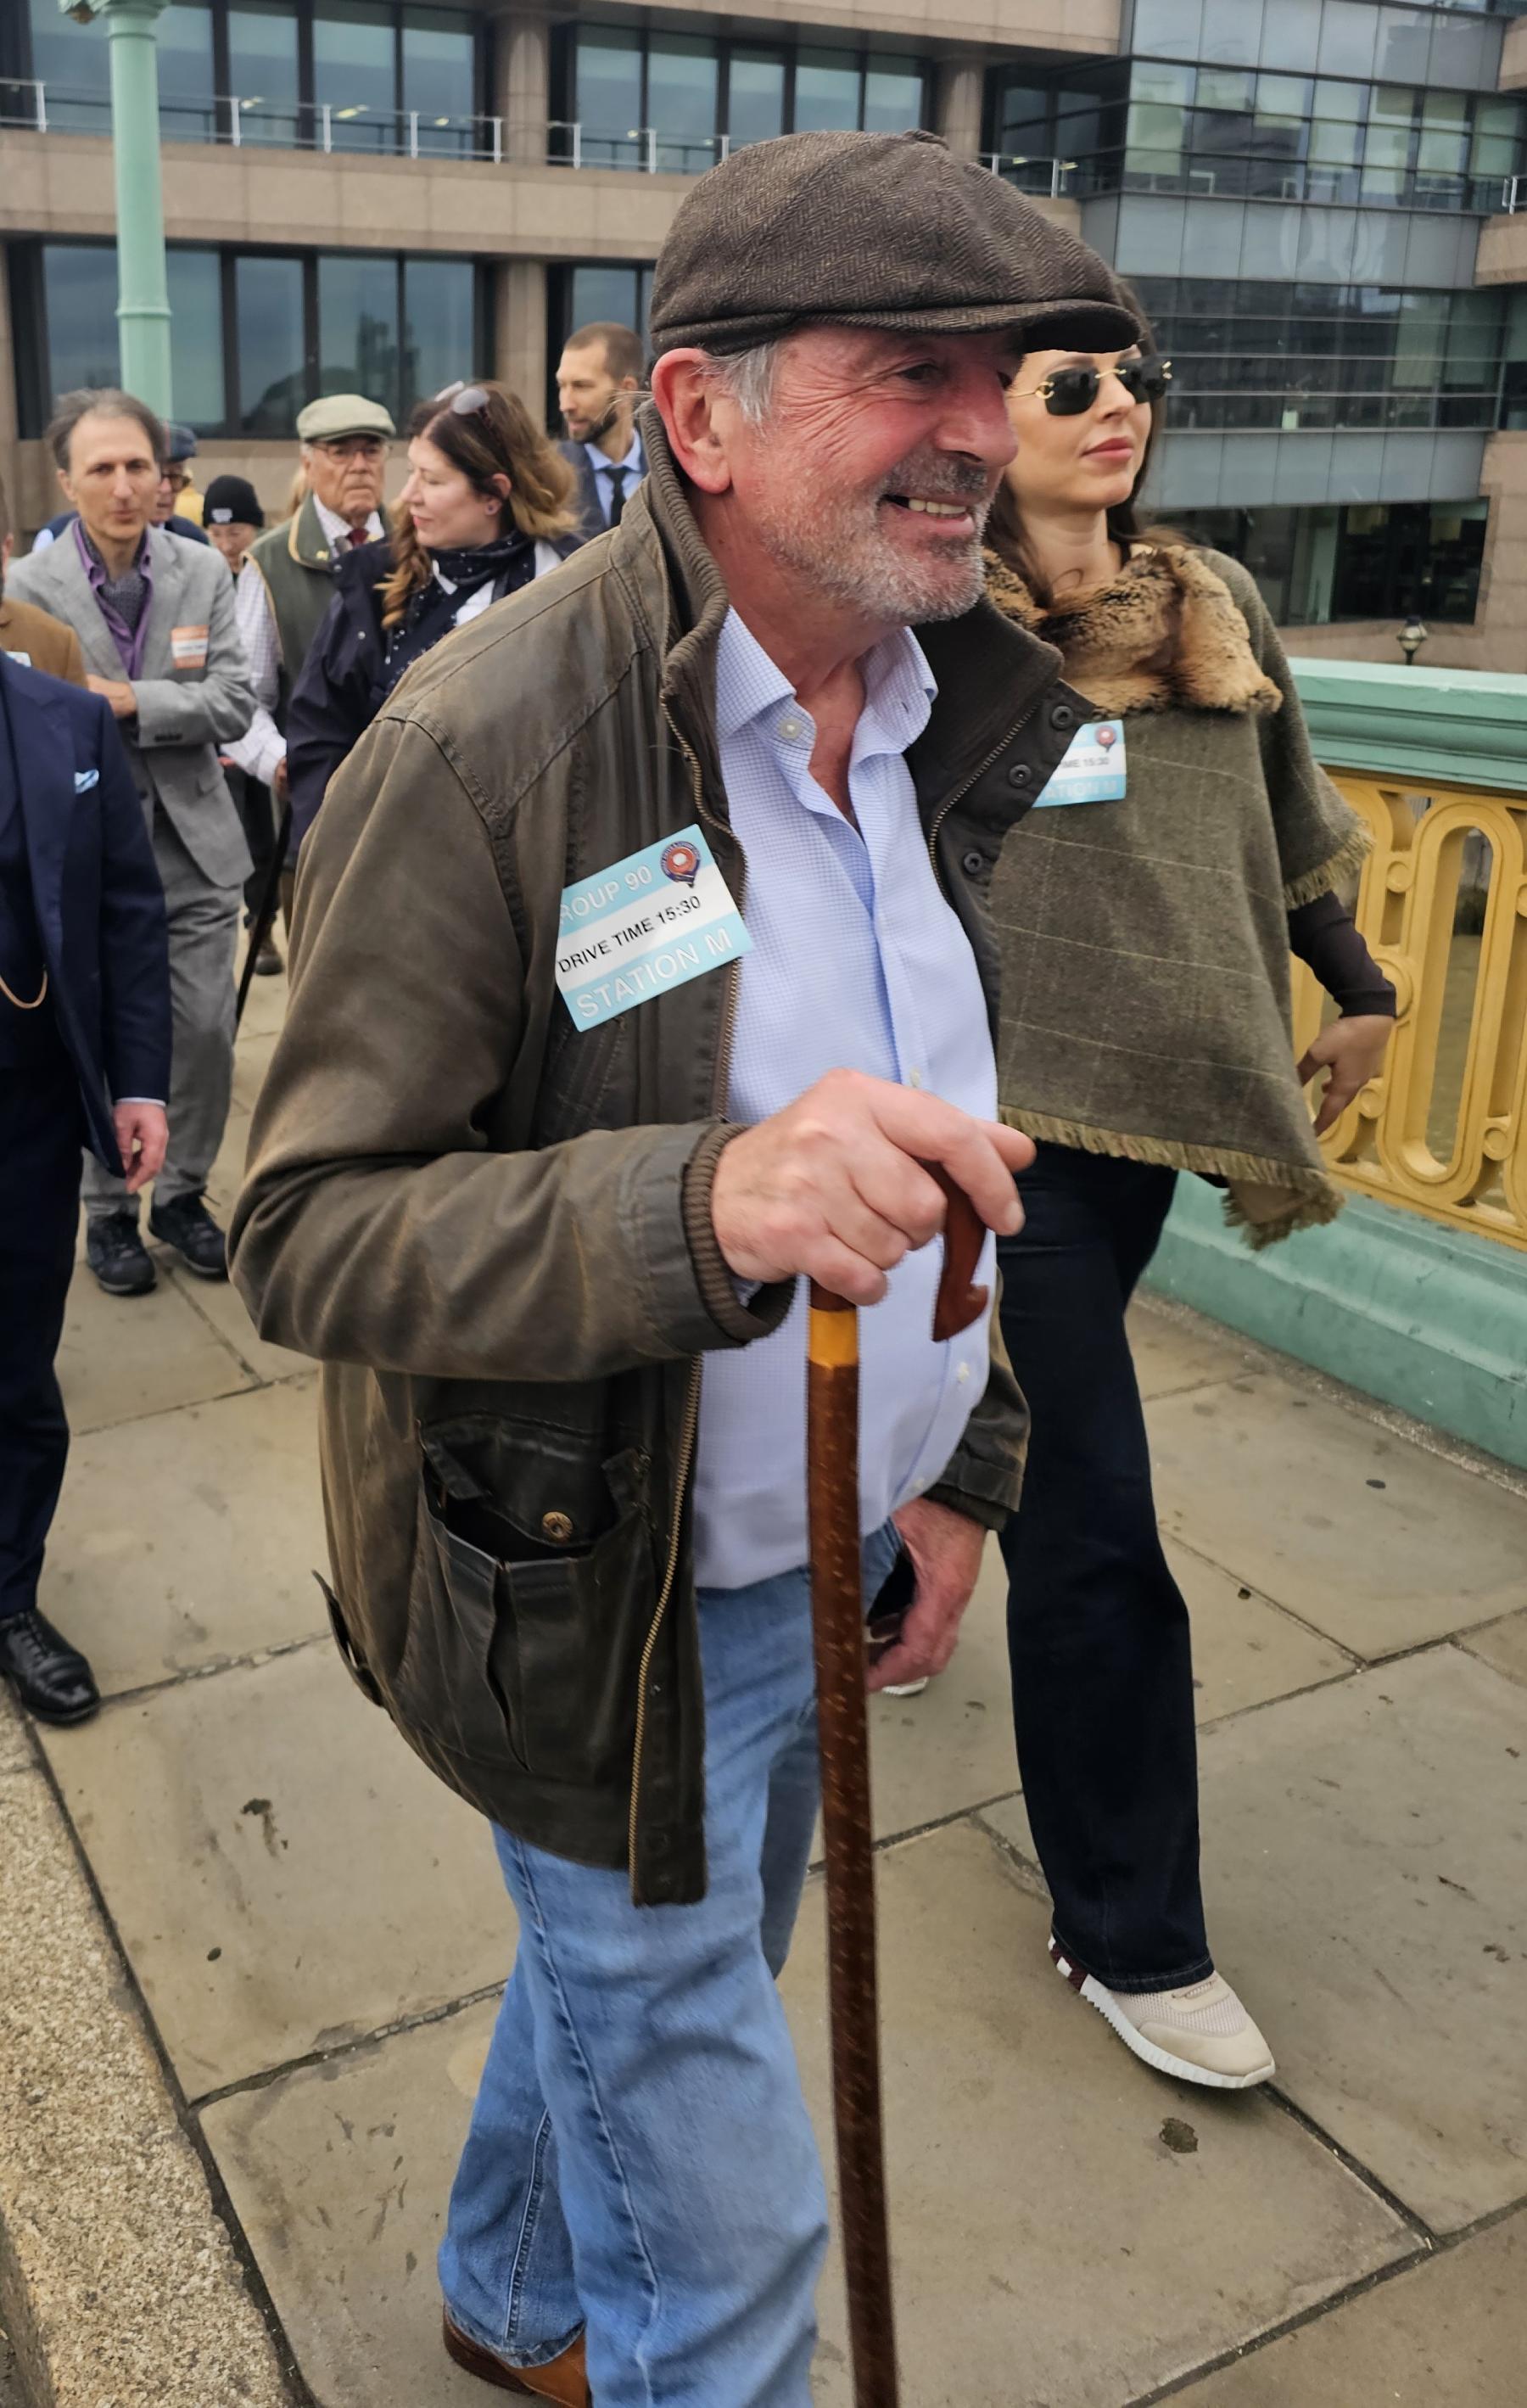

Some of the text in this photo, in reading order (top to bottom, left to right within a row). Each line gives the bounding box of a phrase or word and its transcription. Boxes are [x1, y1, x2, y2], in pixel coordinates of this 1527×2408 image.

[1038, 781, 1100, 799] ATION
[624, 864, 652, 892] 90
[557, 895, 702, 973] DRIVE TIME 15:30
[576, 927, 733, 1019] STATION M
